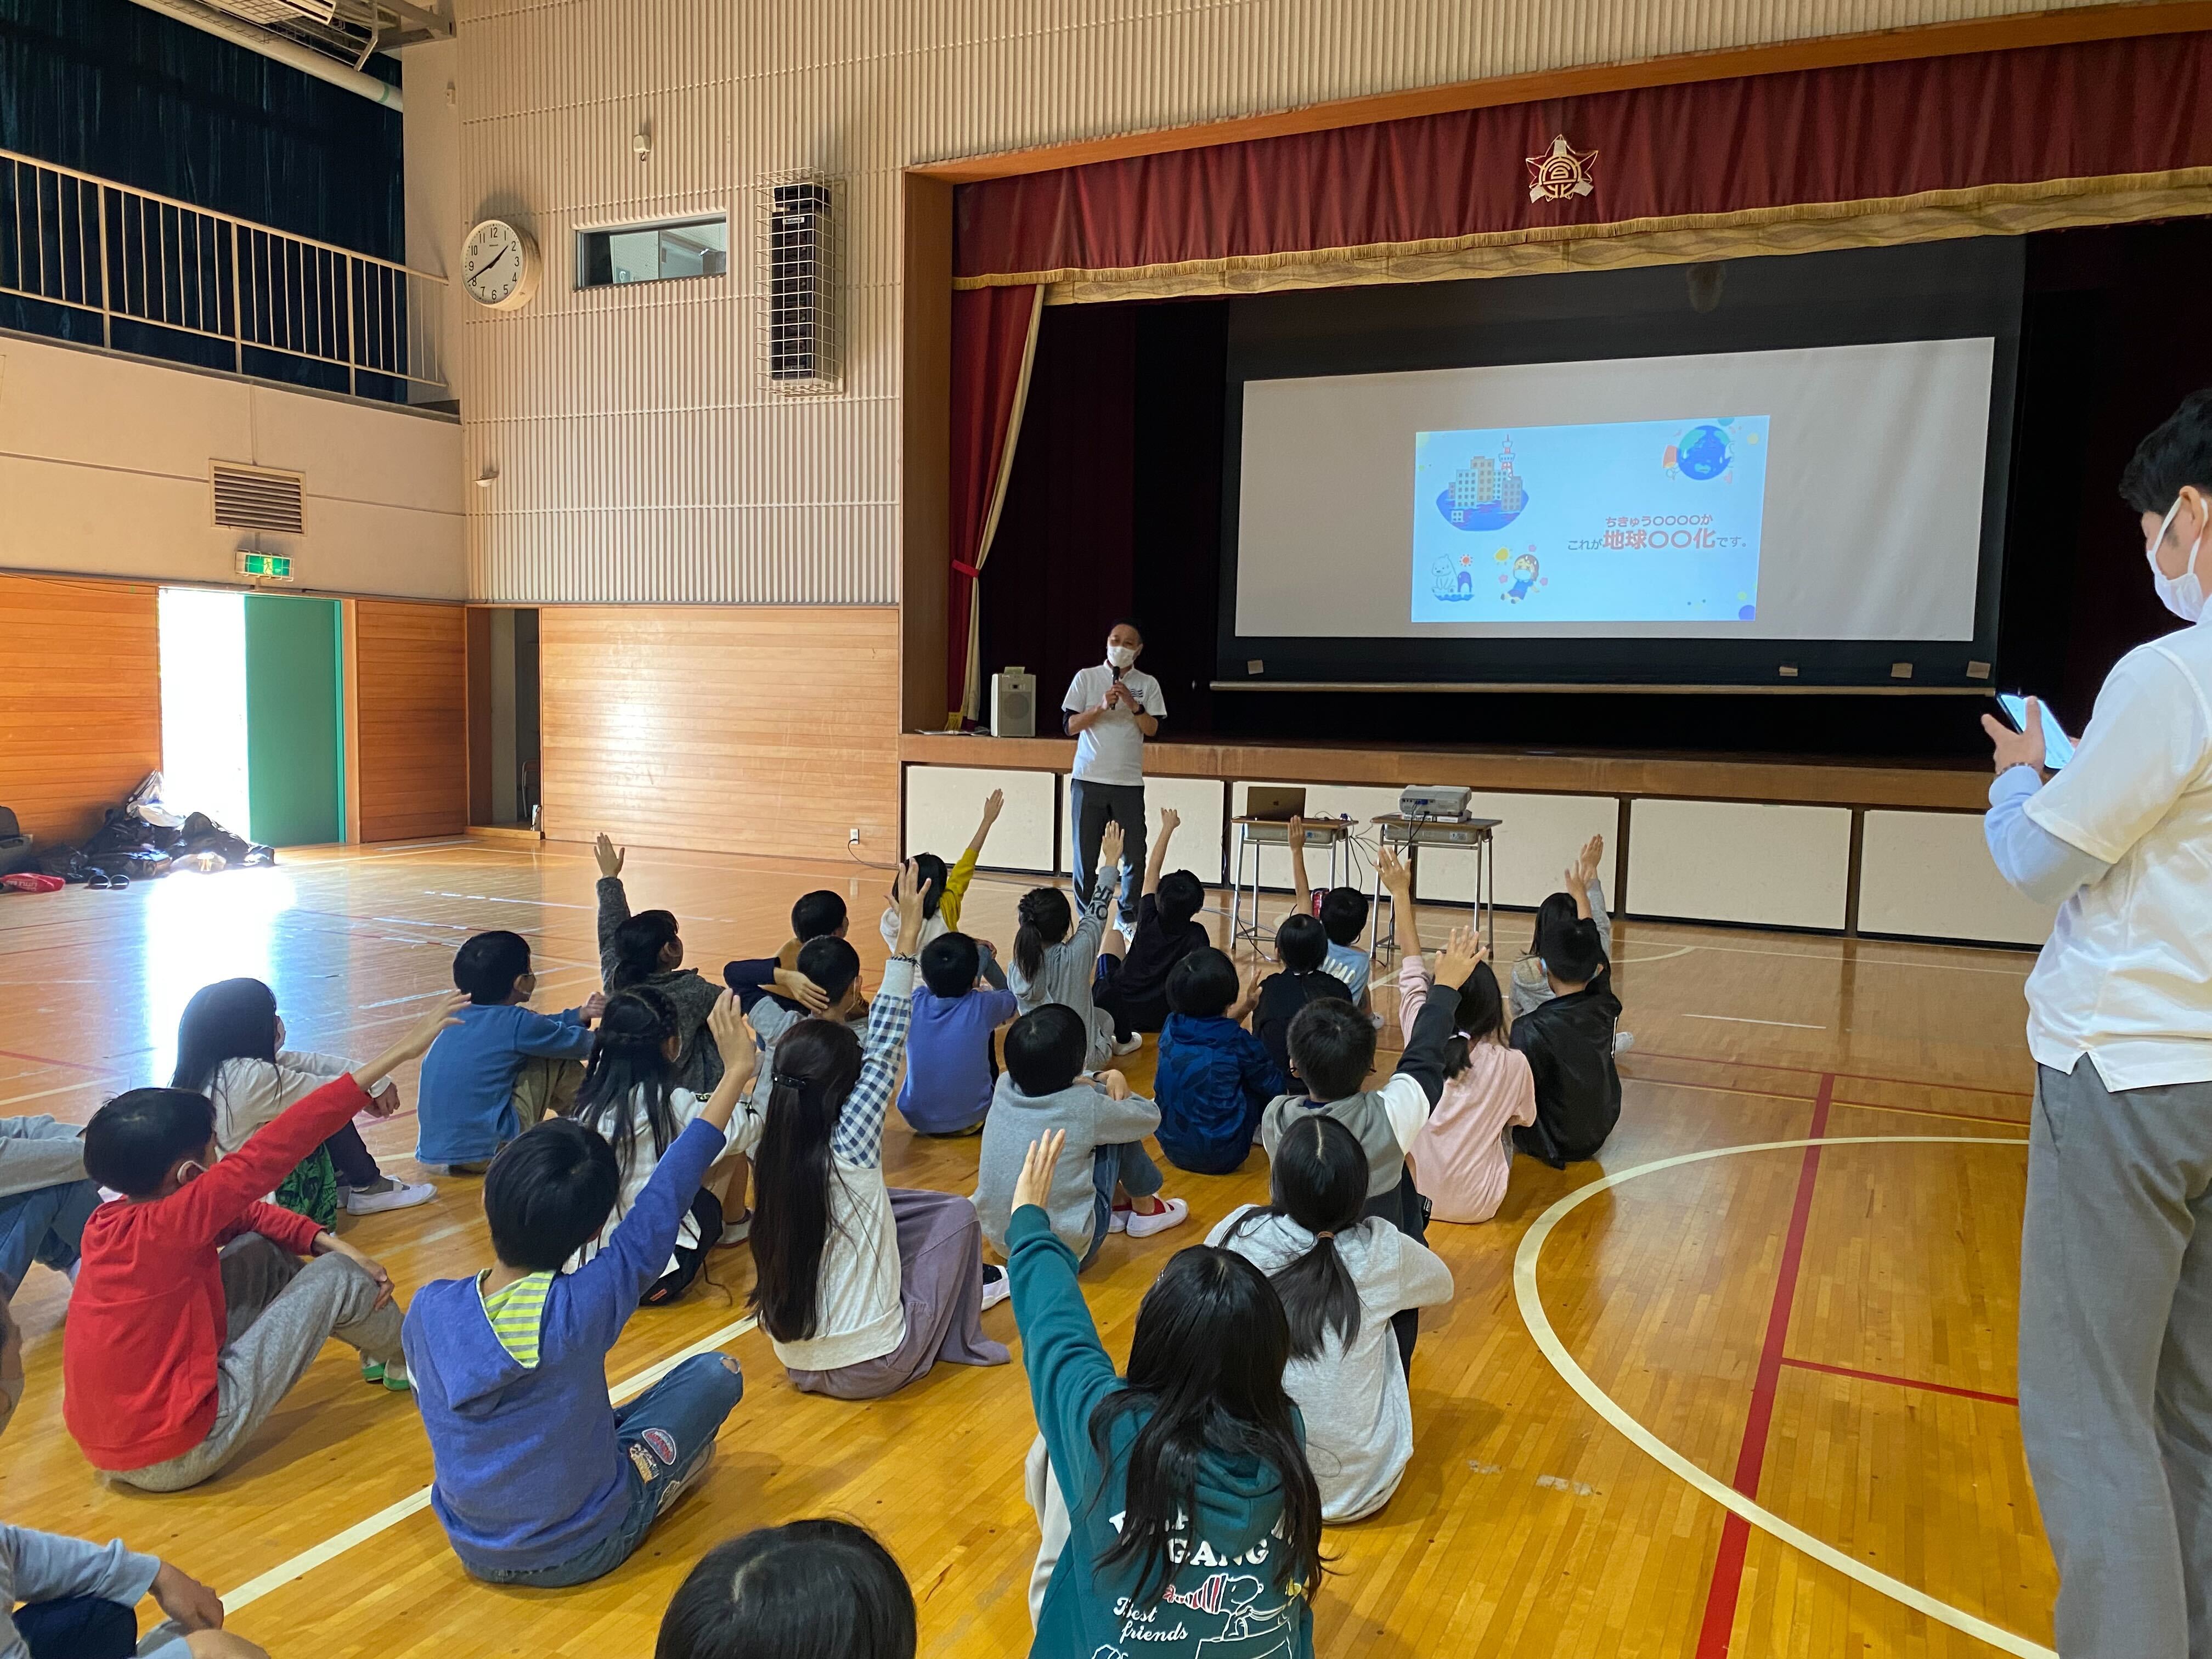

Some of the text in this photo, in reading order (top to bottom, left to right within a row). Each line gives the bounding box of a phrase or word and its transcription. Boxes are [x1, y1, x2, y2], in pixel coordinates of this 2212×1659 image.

[490, 227, 498, 238] 12
[479, 233, 485, 244] 11
[471, 245, 478, 256] 10
[511, 241, 516, 251] 2
[469, 261, 474, 271] 9
[514, 256, 520, 267] 3
[472, 276, 477, 286] 8
[512, 272, 517, 283] 4
[481, 286, 486, 297] 7
[492, 290, 497, 300] 6
[503, 284, 509, 295] 5
[1113, 1597, 1158, 1623] Best
[1119, 1620, 1188, 1644] friends
